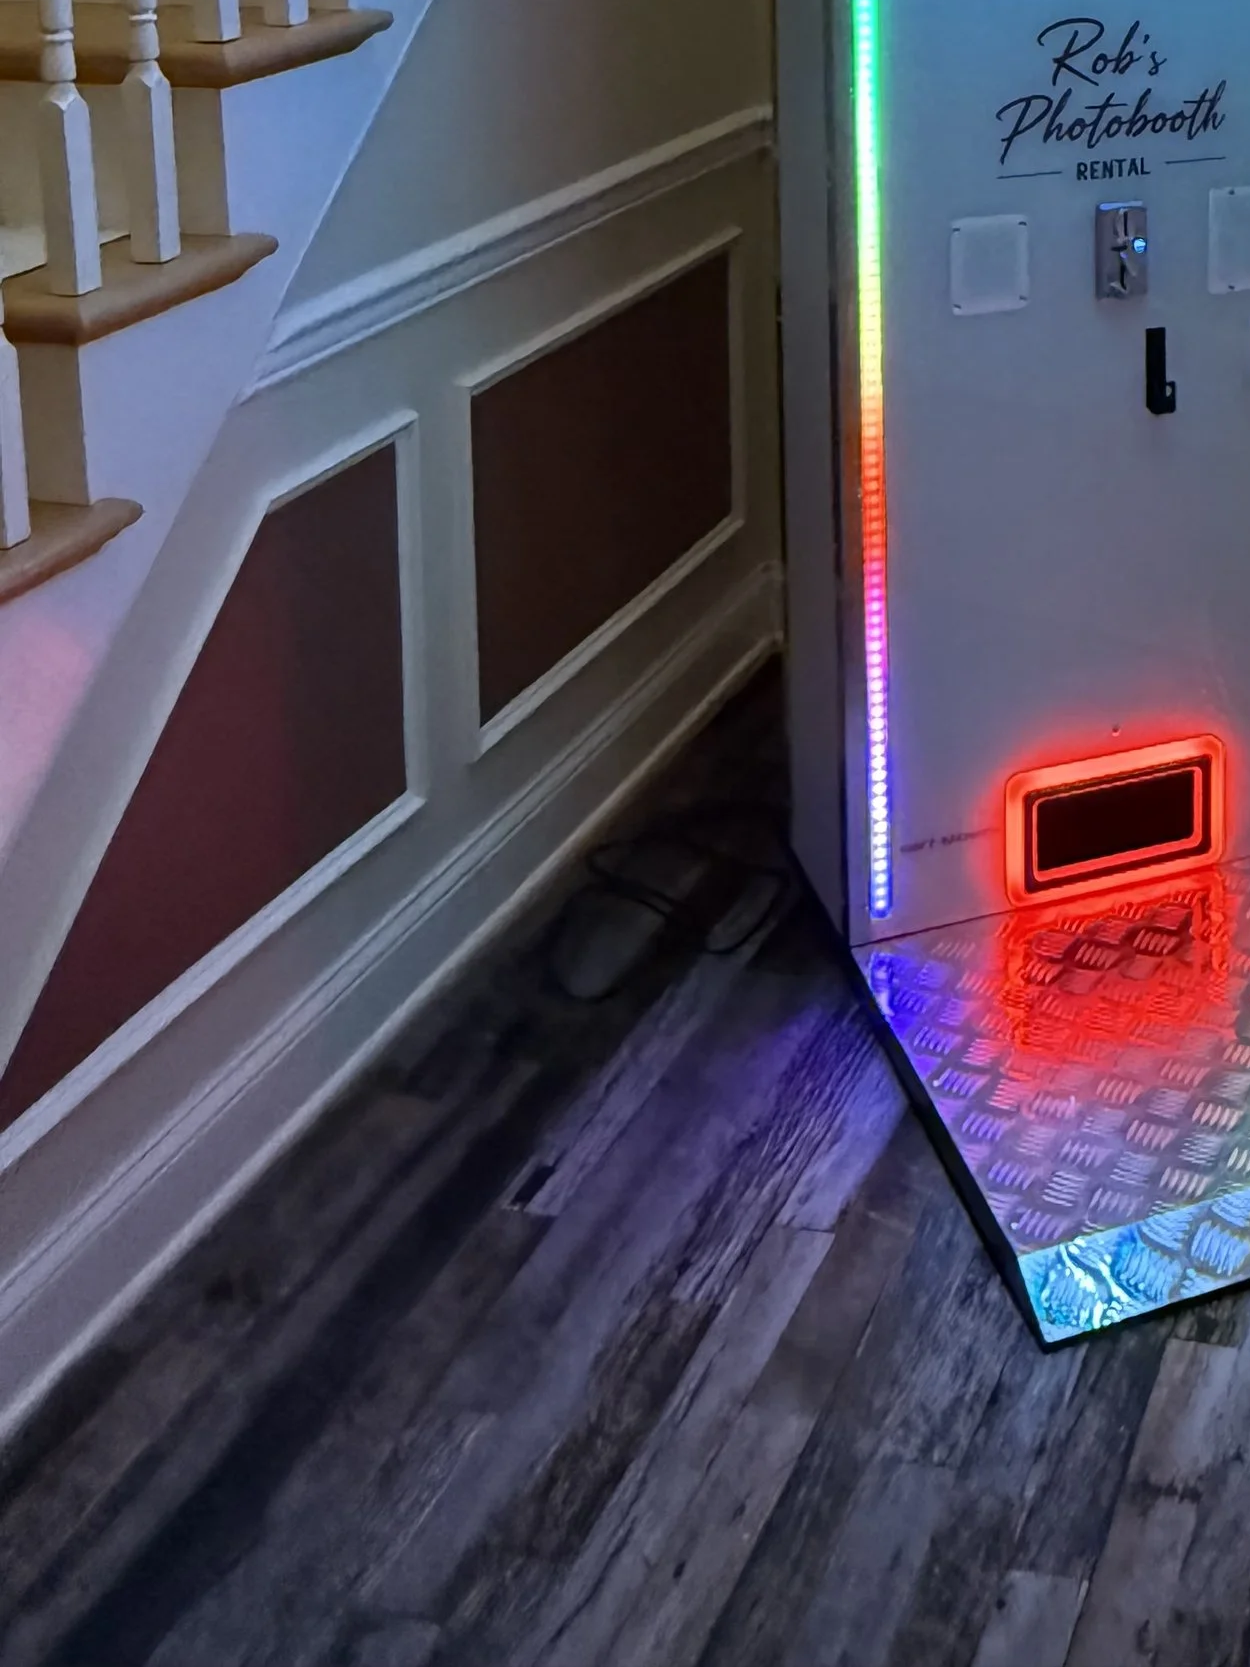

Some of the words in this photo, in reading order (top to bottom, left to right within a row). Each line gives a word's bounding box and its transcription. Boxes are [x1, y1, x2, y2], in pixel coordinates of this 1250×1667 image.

[1036, 17, 1167, 87] Rob's
[995, 80, 1227, 165] Photobooth
[1076, 157, 1151, 181] RENTAL
